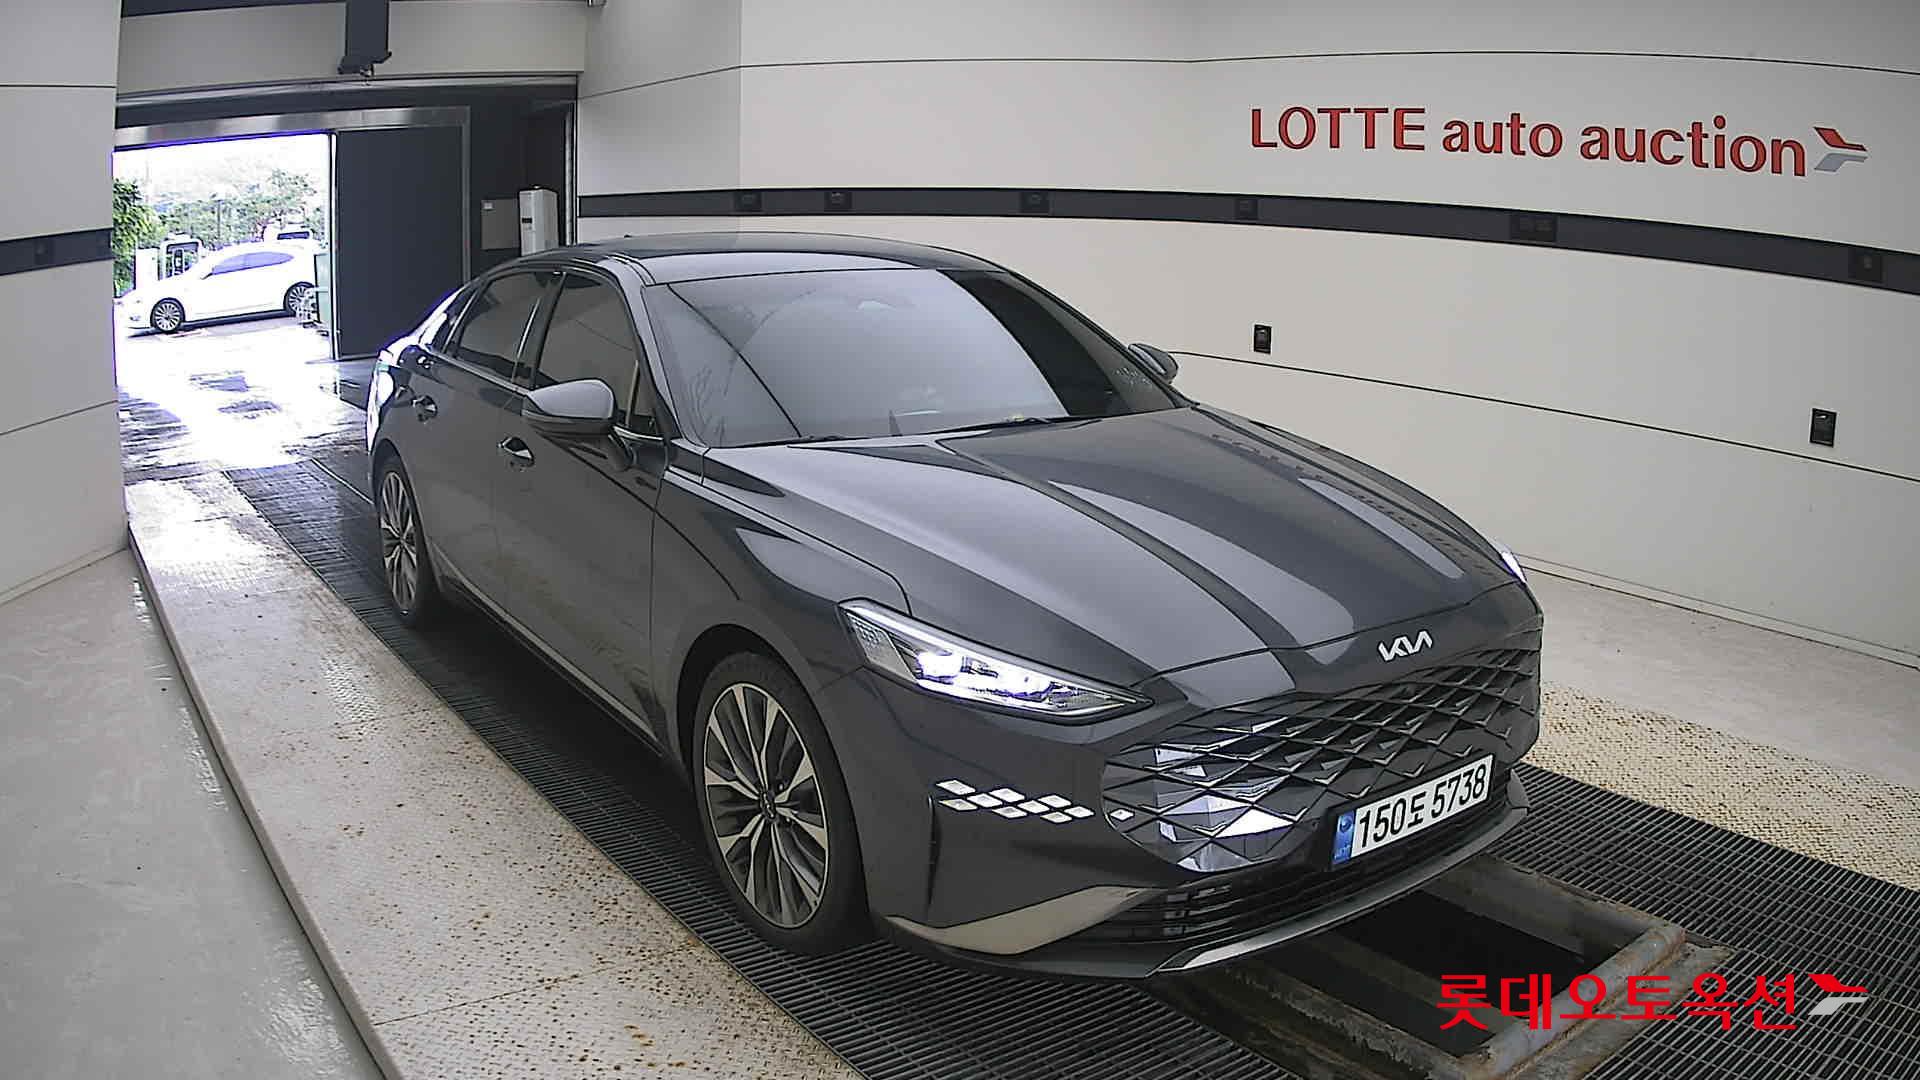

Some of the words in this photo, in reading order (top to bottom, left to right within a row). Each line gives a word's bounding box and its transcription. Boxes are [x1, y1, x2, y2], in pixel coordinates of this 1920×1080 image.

[1251, 106, 1426, 150] LOTTE
[1442, 112, 1563, 158] auto
[1579, 115, 1807, 178] auction
[1378, 630, 1433, 662] KIA
[1359, 791, 1426, 849] 150도
[1431, 763, 1487, 821] 5738
